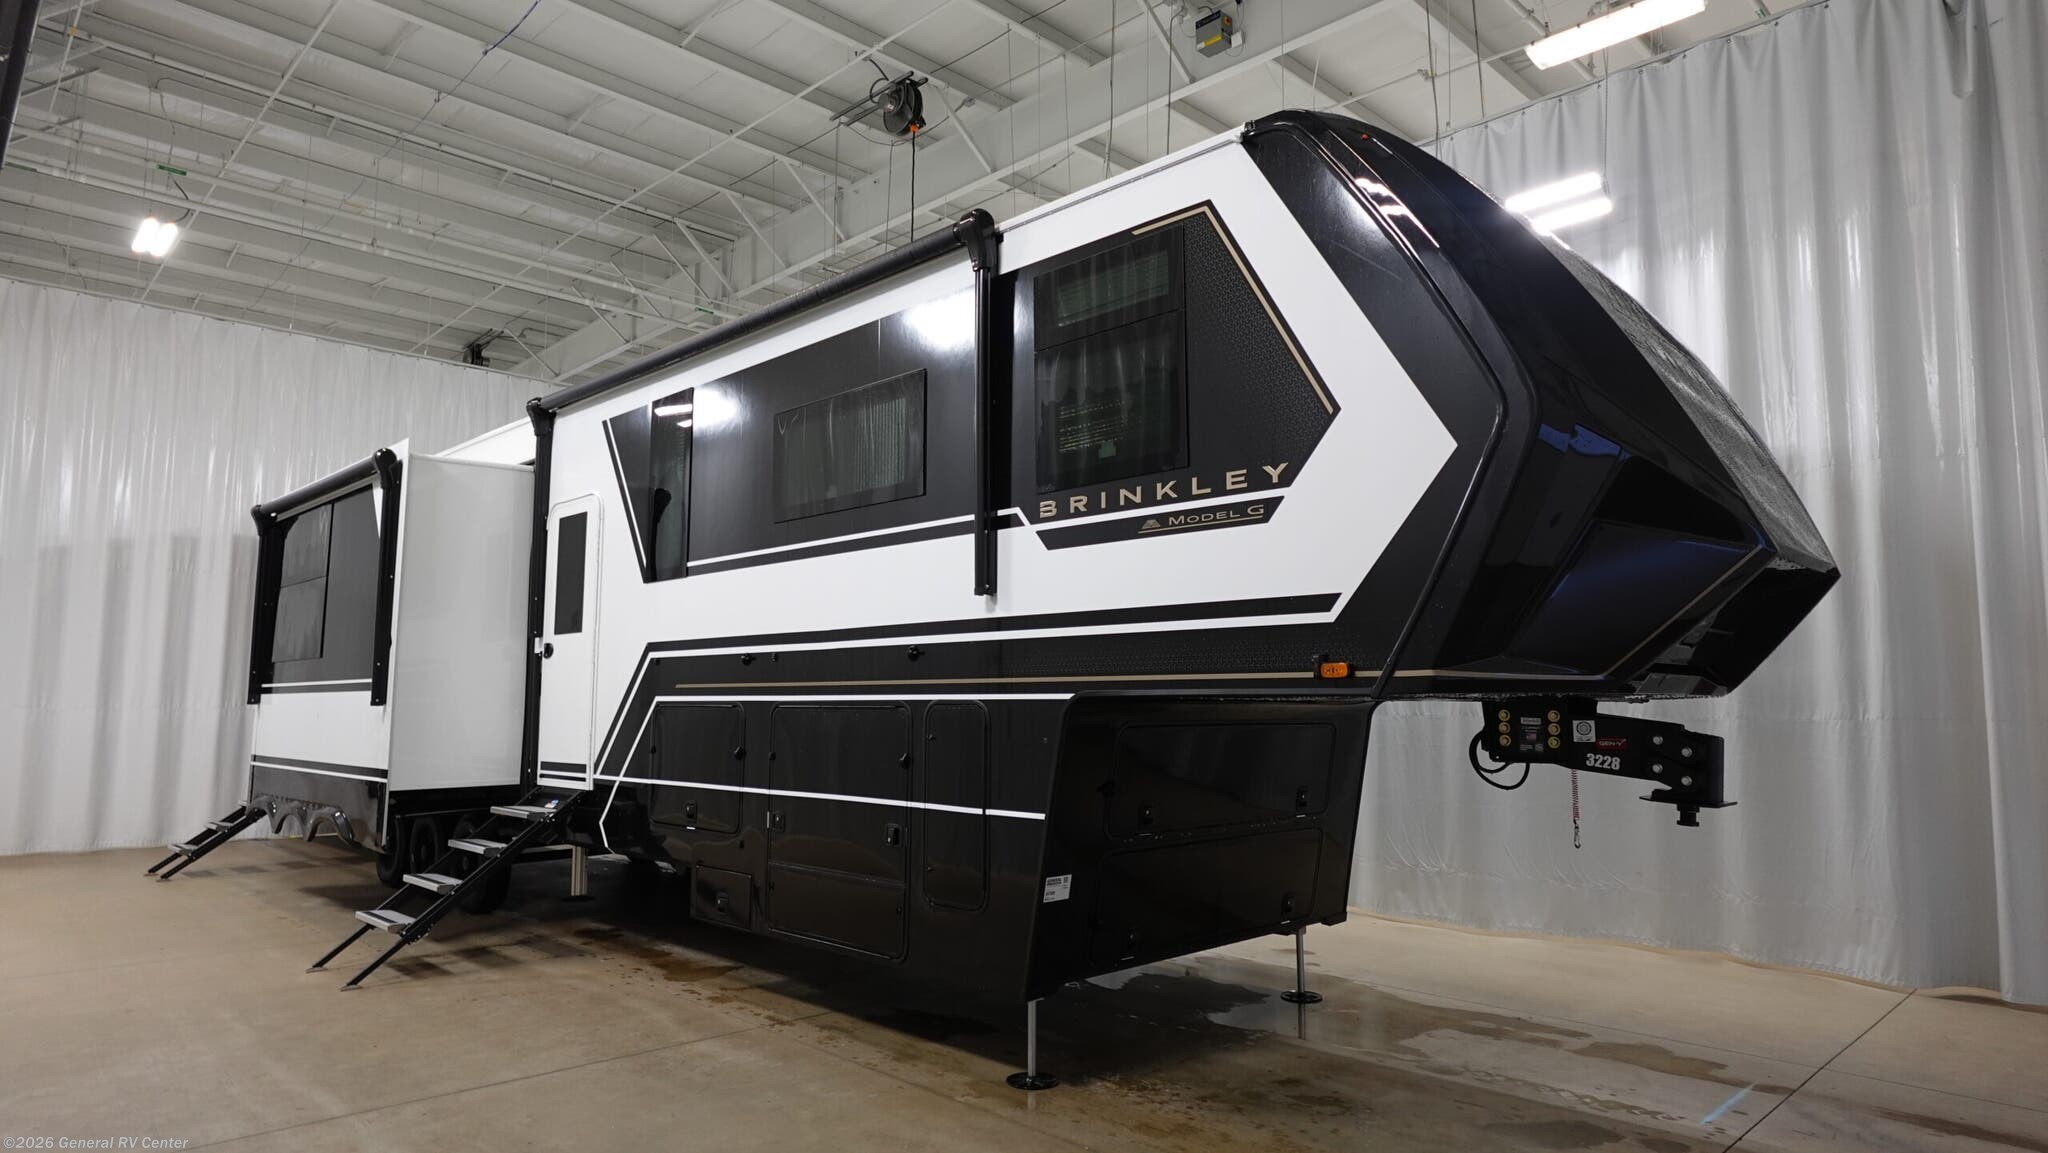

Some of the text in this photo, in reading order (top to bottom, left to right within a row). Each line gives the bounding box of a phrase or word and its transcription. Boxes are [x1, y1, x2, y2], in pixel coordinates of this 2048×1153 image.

[1039, 462, 1289, 519] BRINKLEY
[1246, 504, 1265, 516] G
[1586, 753, 1621, 770] 3228
